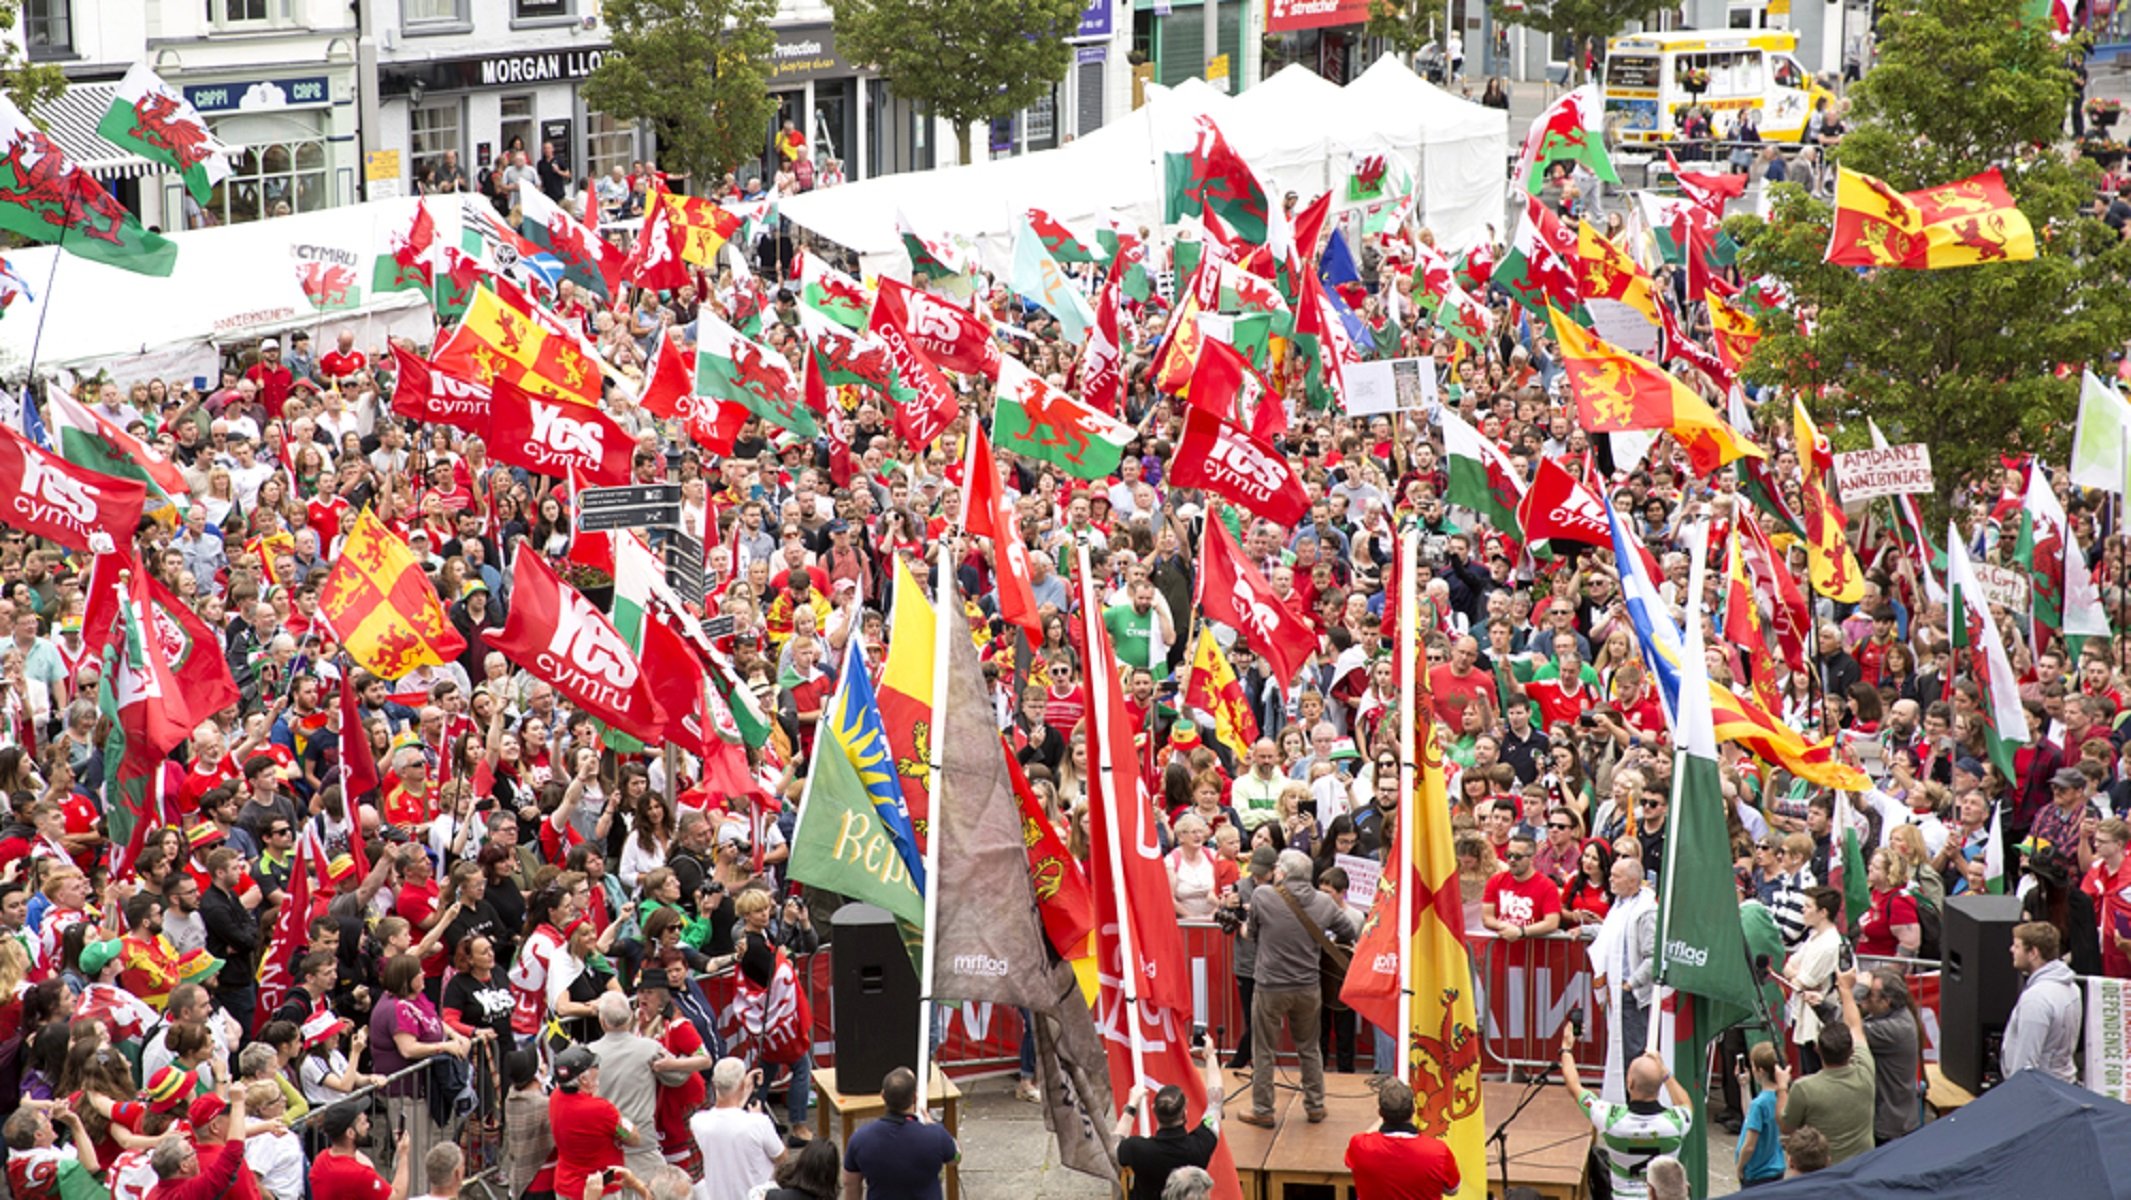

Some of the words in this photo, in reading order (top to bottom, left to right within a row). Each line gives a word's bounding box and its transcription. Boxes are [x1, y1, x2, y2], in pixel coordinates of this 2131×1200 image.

[772, 40, 821, 58] Protection
[482, 55, 559, 84] MORGAN
[195, 90, 228, 106] CAPPI
[297, 244, 357, 266] CYMRU
[901, 288, 963, 341] Yes
[530, 398, 604, 464] Yes
[523, 442, 600, 471] cymru
[1208, 423, 1288, 491] Yes
[1843, 443, 1921, 468] AMDANI
[14, 438, 101, 523] Yes
[1204, 460, 1272, 502] cymru
[548, 582, 639, 688] Yes
[536, 653, 632, 712] cymru
[1499, 890, 1534, 919] Yes
[954, 953, 1009, 975] mrflag
[473, 988, 516, 1014] Yes
